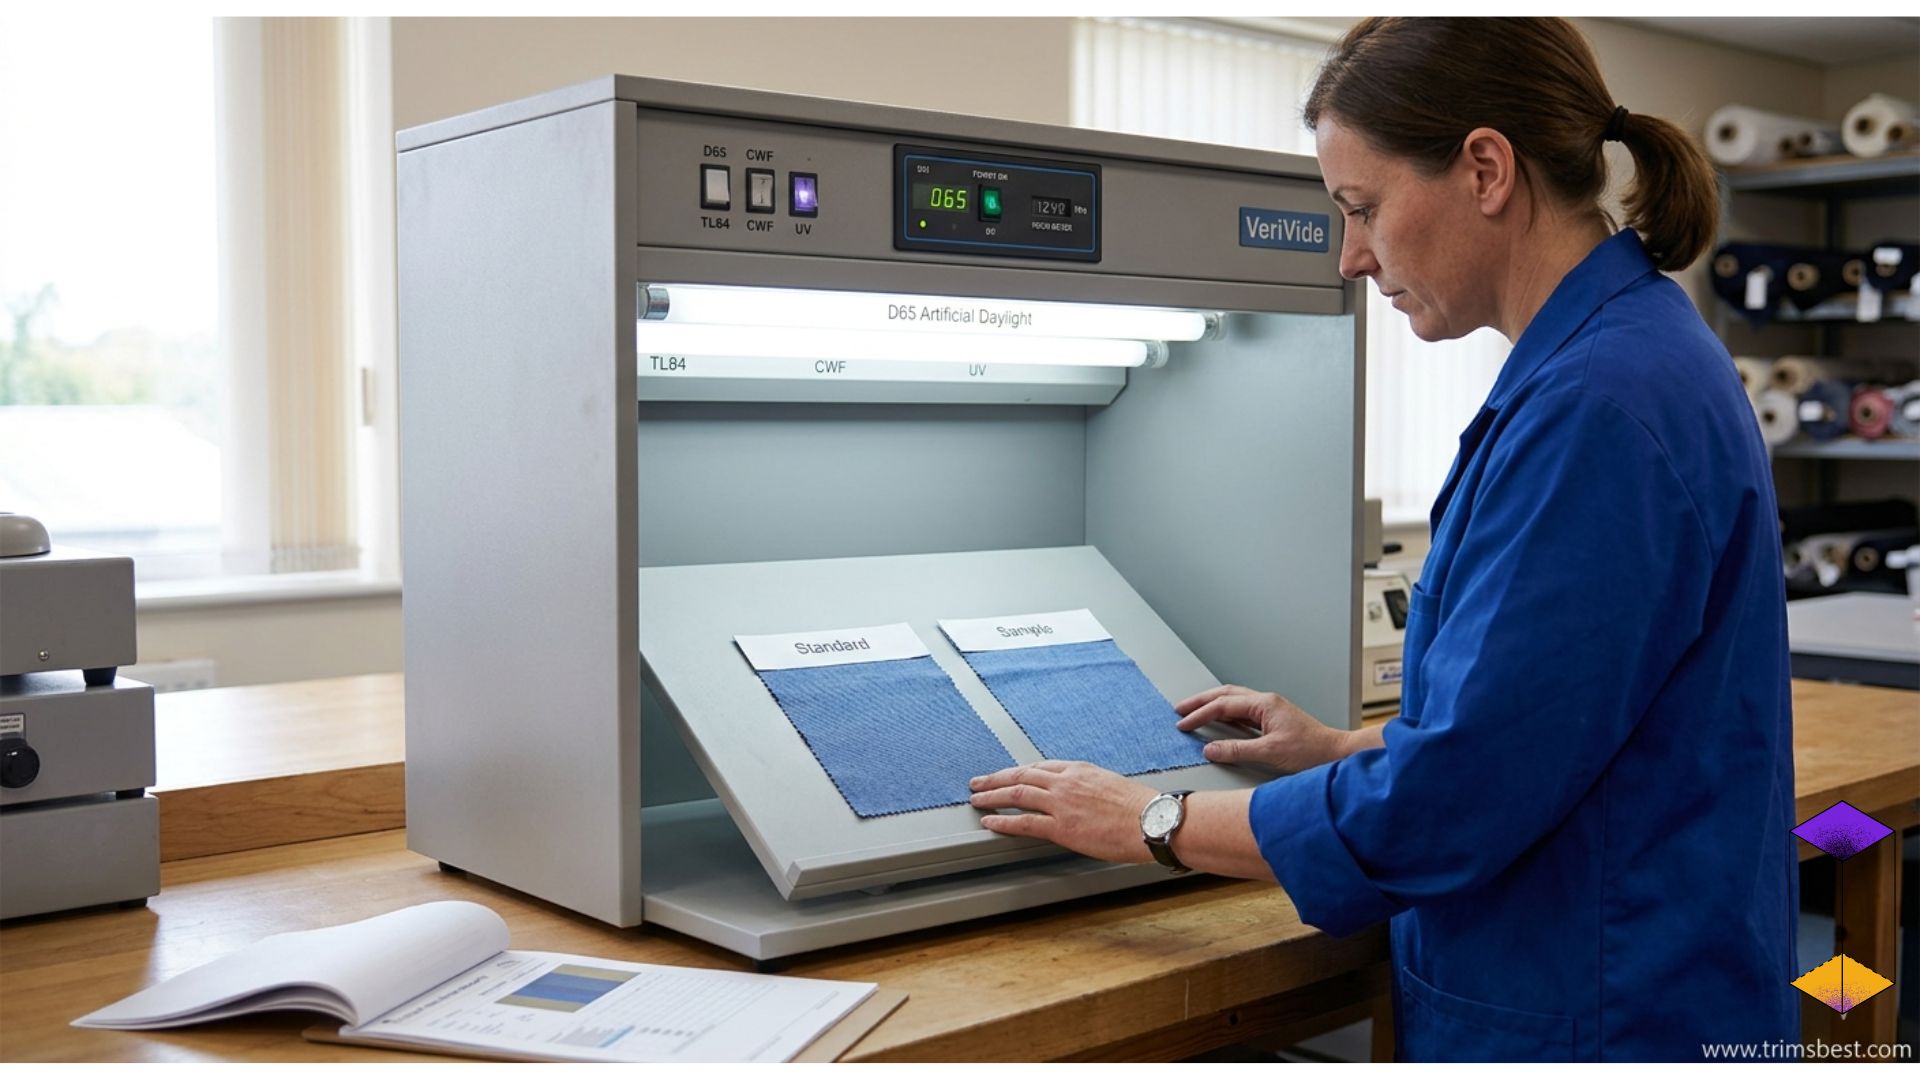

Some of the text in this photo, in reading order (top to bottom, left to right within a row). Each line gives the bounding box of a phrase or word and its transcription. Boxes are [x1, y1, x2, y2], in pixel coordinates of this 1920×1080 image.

[746, 149, 774, 162] CWF
[701, 217, 730, 229] TL84
[747, 220, 774, 232] CWF
[795, 224, 812, 235] UV
[1246, 216, 1324, 244] VeriVide
[888, 305, 1033, 328] D65 Artificial Daylight
[650, 356, 686, 372] TL84
[815, 360, 846, 374] CWF
[969, 363, 987, 377] UV
[794, 638, 871, 656] Standard
